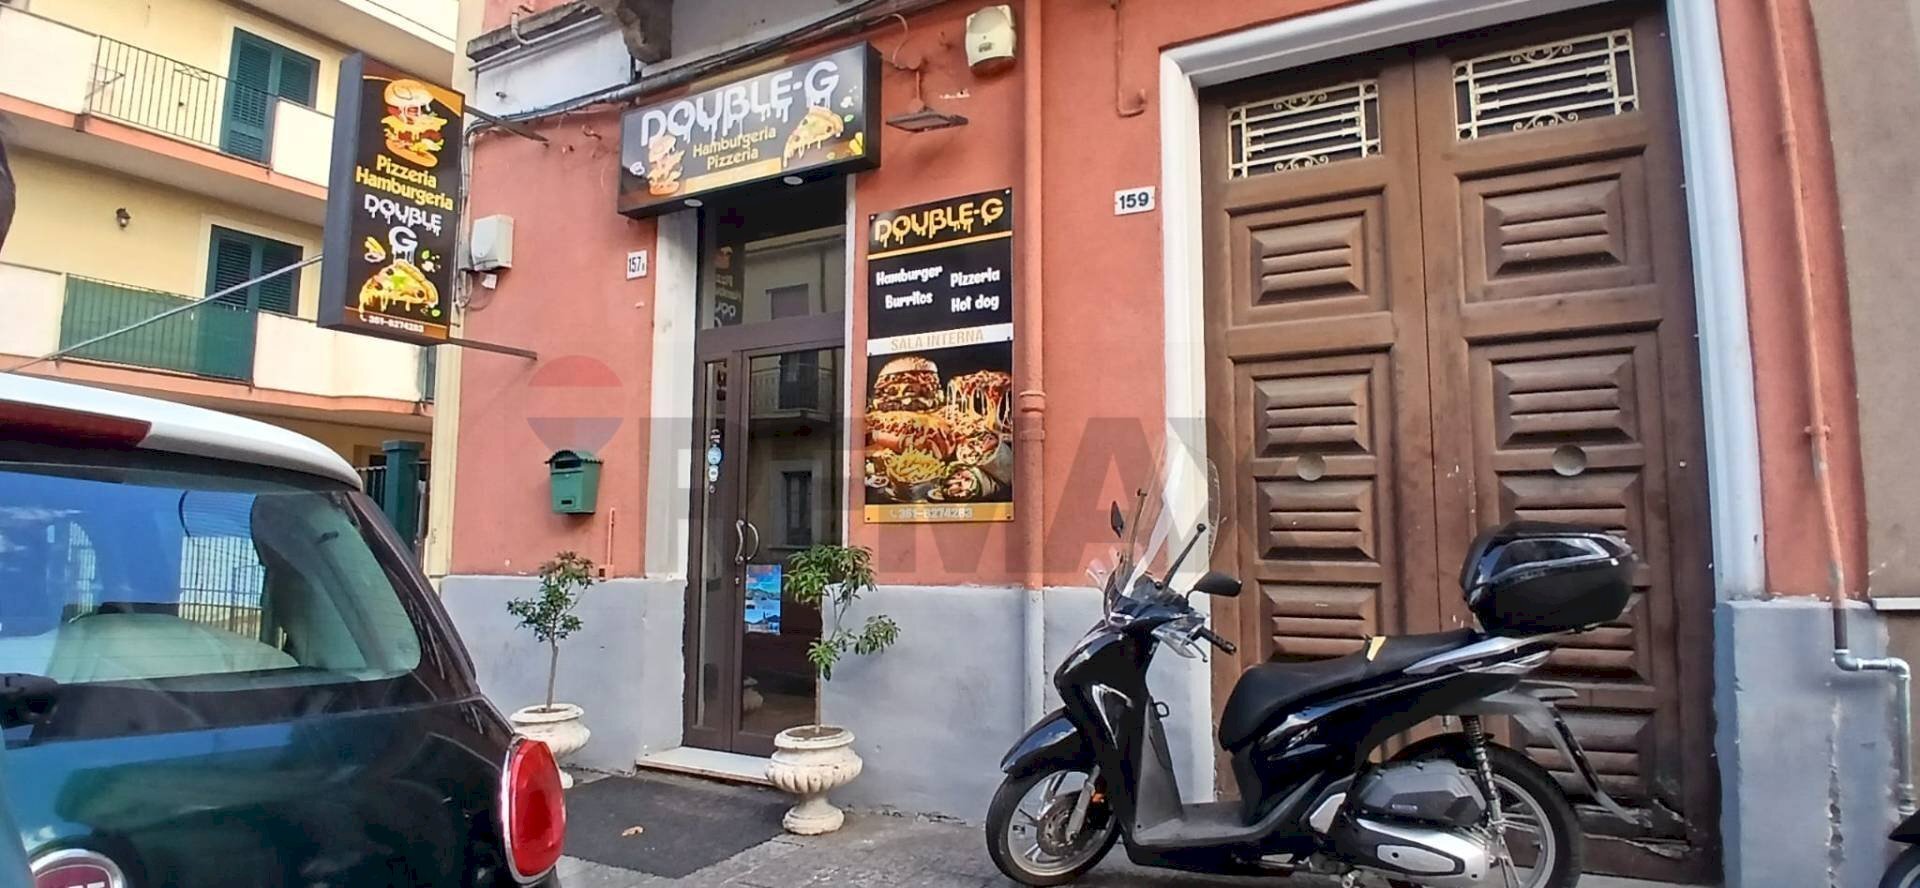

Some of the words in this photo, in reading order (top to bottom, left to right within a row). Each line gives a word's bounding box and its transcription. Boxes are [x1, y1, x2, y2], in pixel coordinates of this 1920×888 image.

[640, 60, 840, 146] DOUBLE-G
[692, 125, 777, 159] Hamburgeria
[376, 153, 437, 189] Pizzeria
[706, 146, 759, 170] Pizzeria
[355, 165, 454, 211] Hamburgeria
[1119, 191, 1150, 210] 159
[363, 193, 442, 234] DOUBLE
[874, 198, 1004, 248] DOUBLE-G
[388, 225, 418, 259] G
[875, 265, 943, 286] Hamburger
[950, 267, 1000, 288] Pizzeria
[884, 290, 933, 309] Burritos
[951, 296, 972, 313] Hot
[974, 294, 1000, 311] dog
[890, 336, 925, 352] SALA
[927, 328, 985, 347] INTERNA
